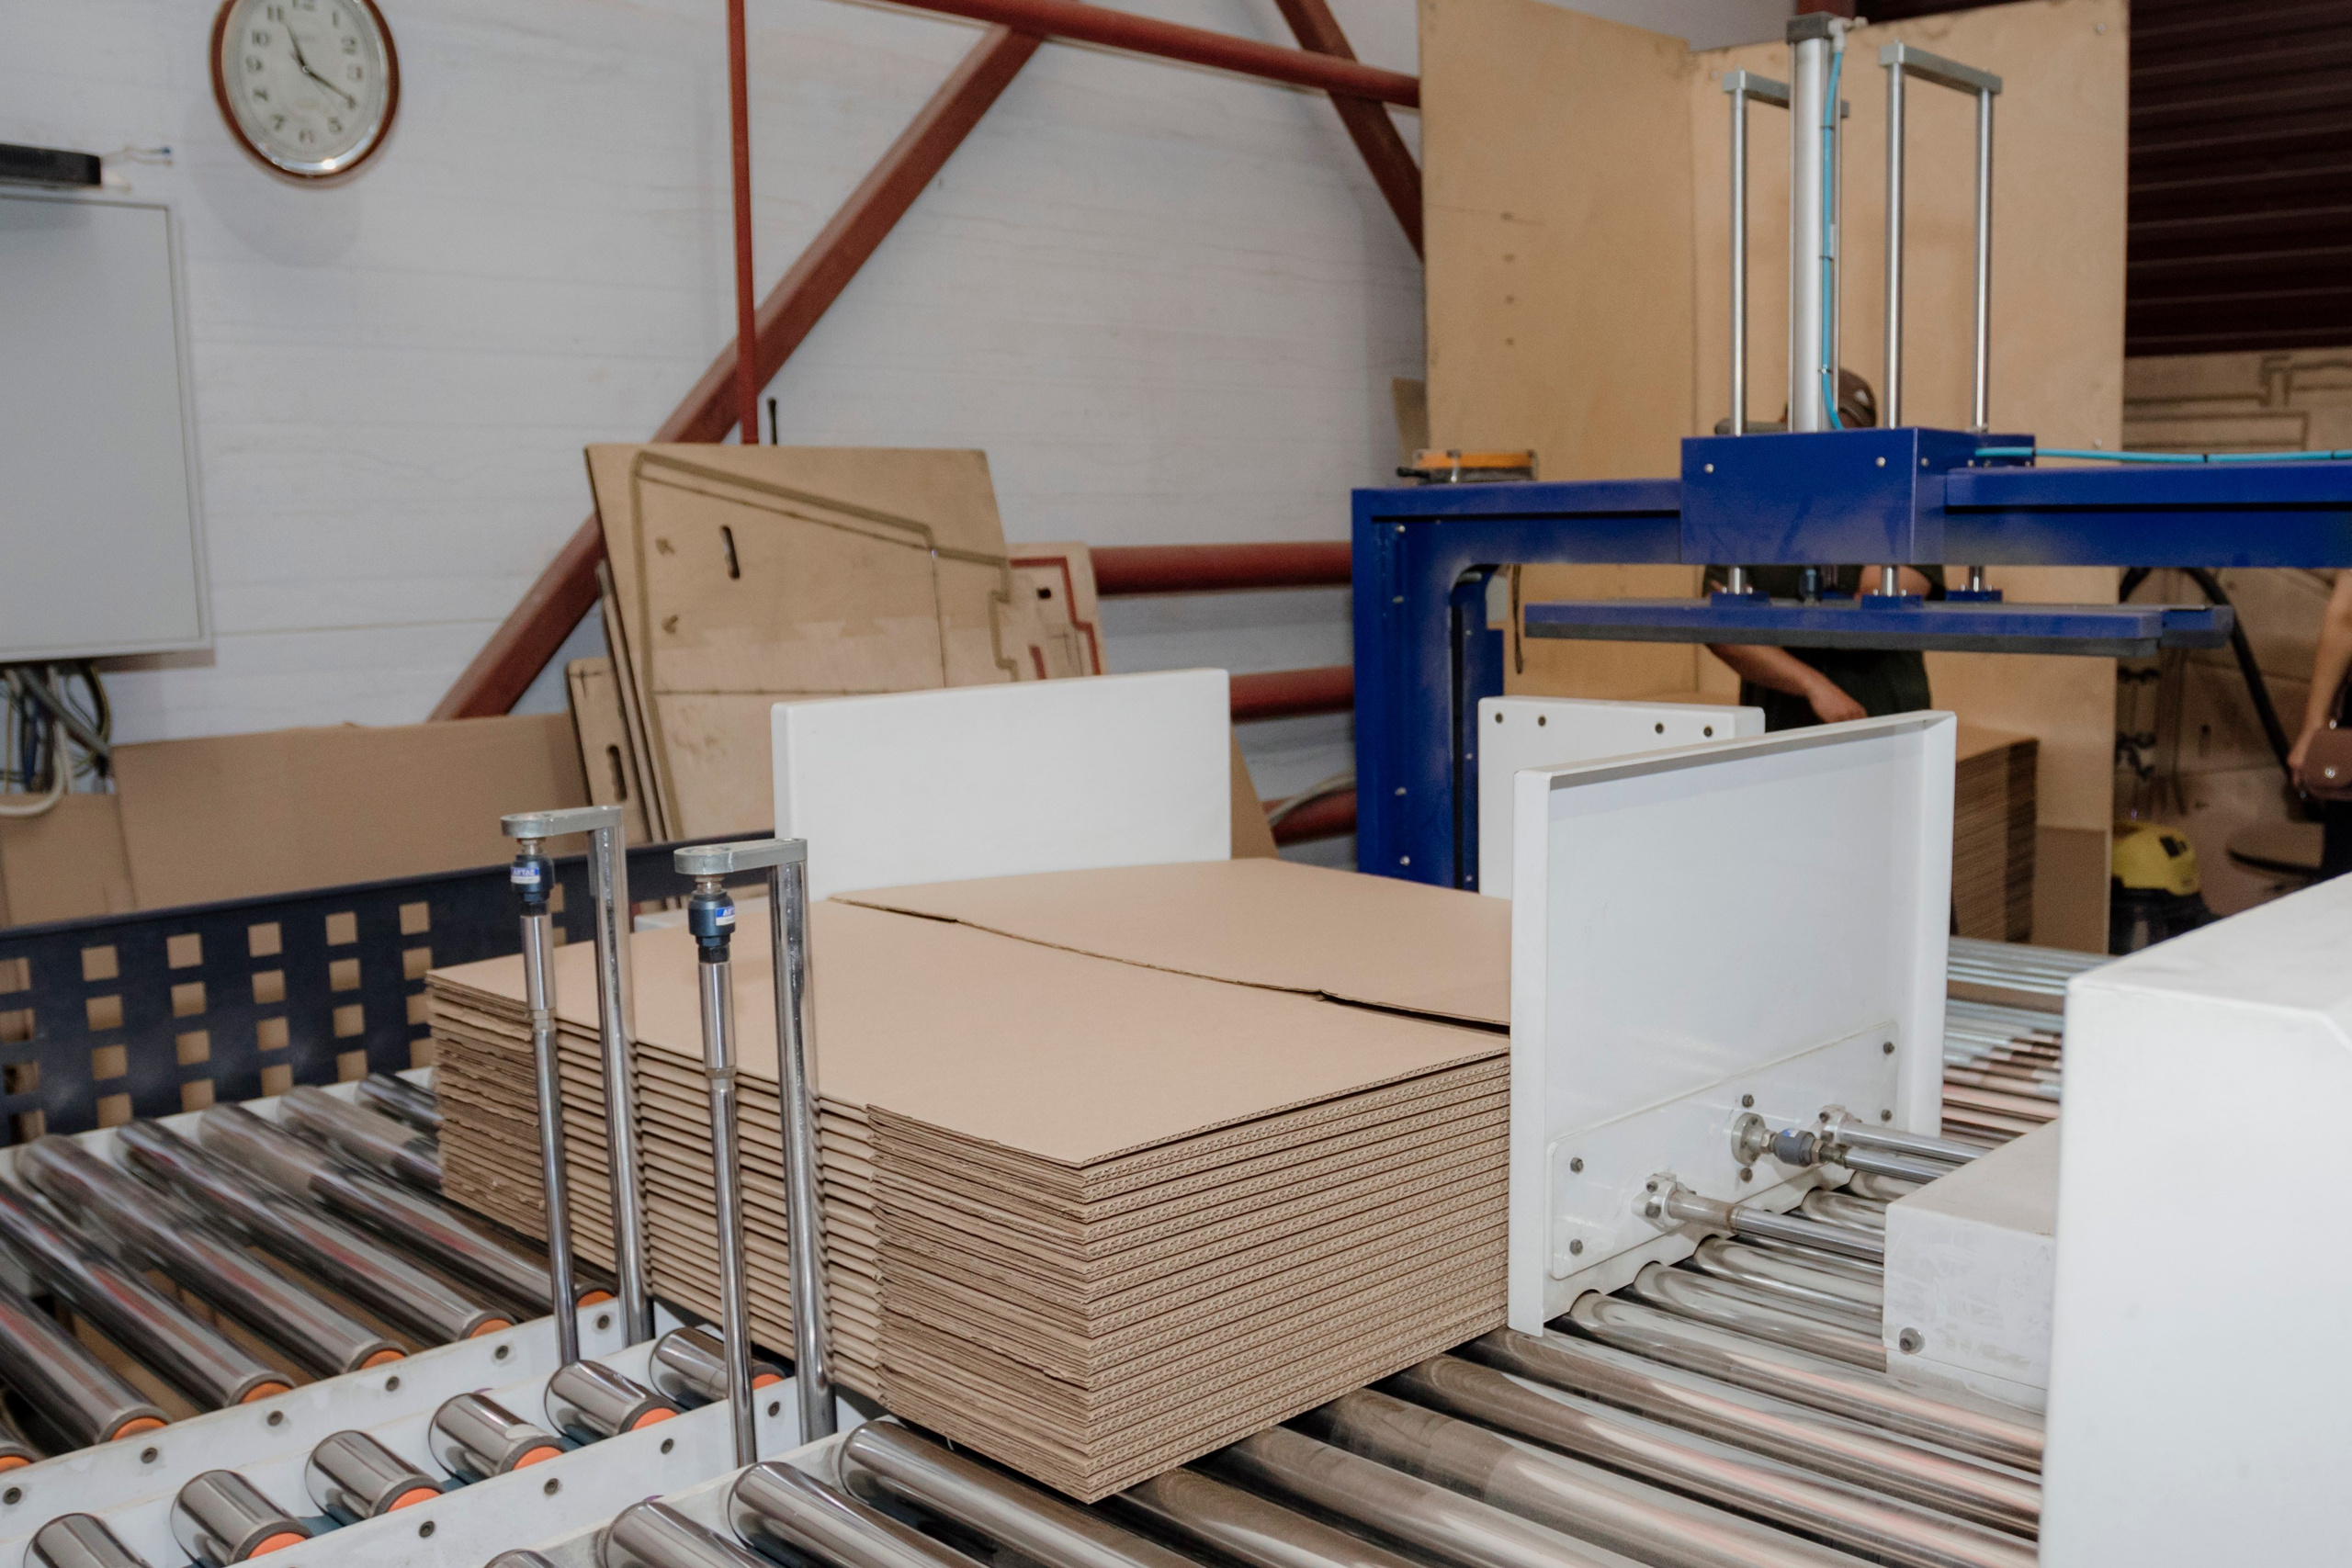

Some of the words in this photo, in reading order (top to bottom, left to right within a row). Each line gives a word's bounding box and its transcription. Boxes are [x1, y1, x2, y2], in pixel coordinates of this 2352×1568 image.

[266, 6, 283, 22] 11
[332, 10, 339, 28] 1
[251, 29, 270, 47] 10
[341, 36, 356, 54] 2
[245, 56, 263, 73] 9
[270, 113, 287, 131] 7
